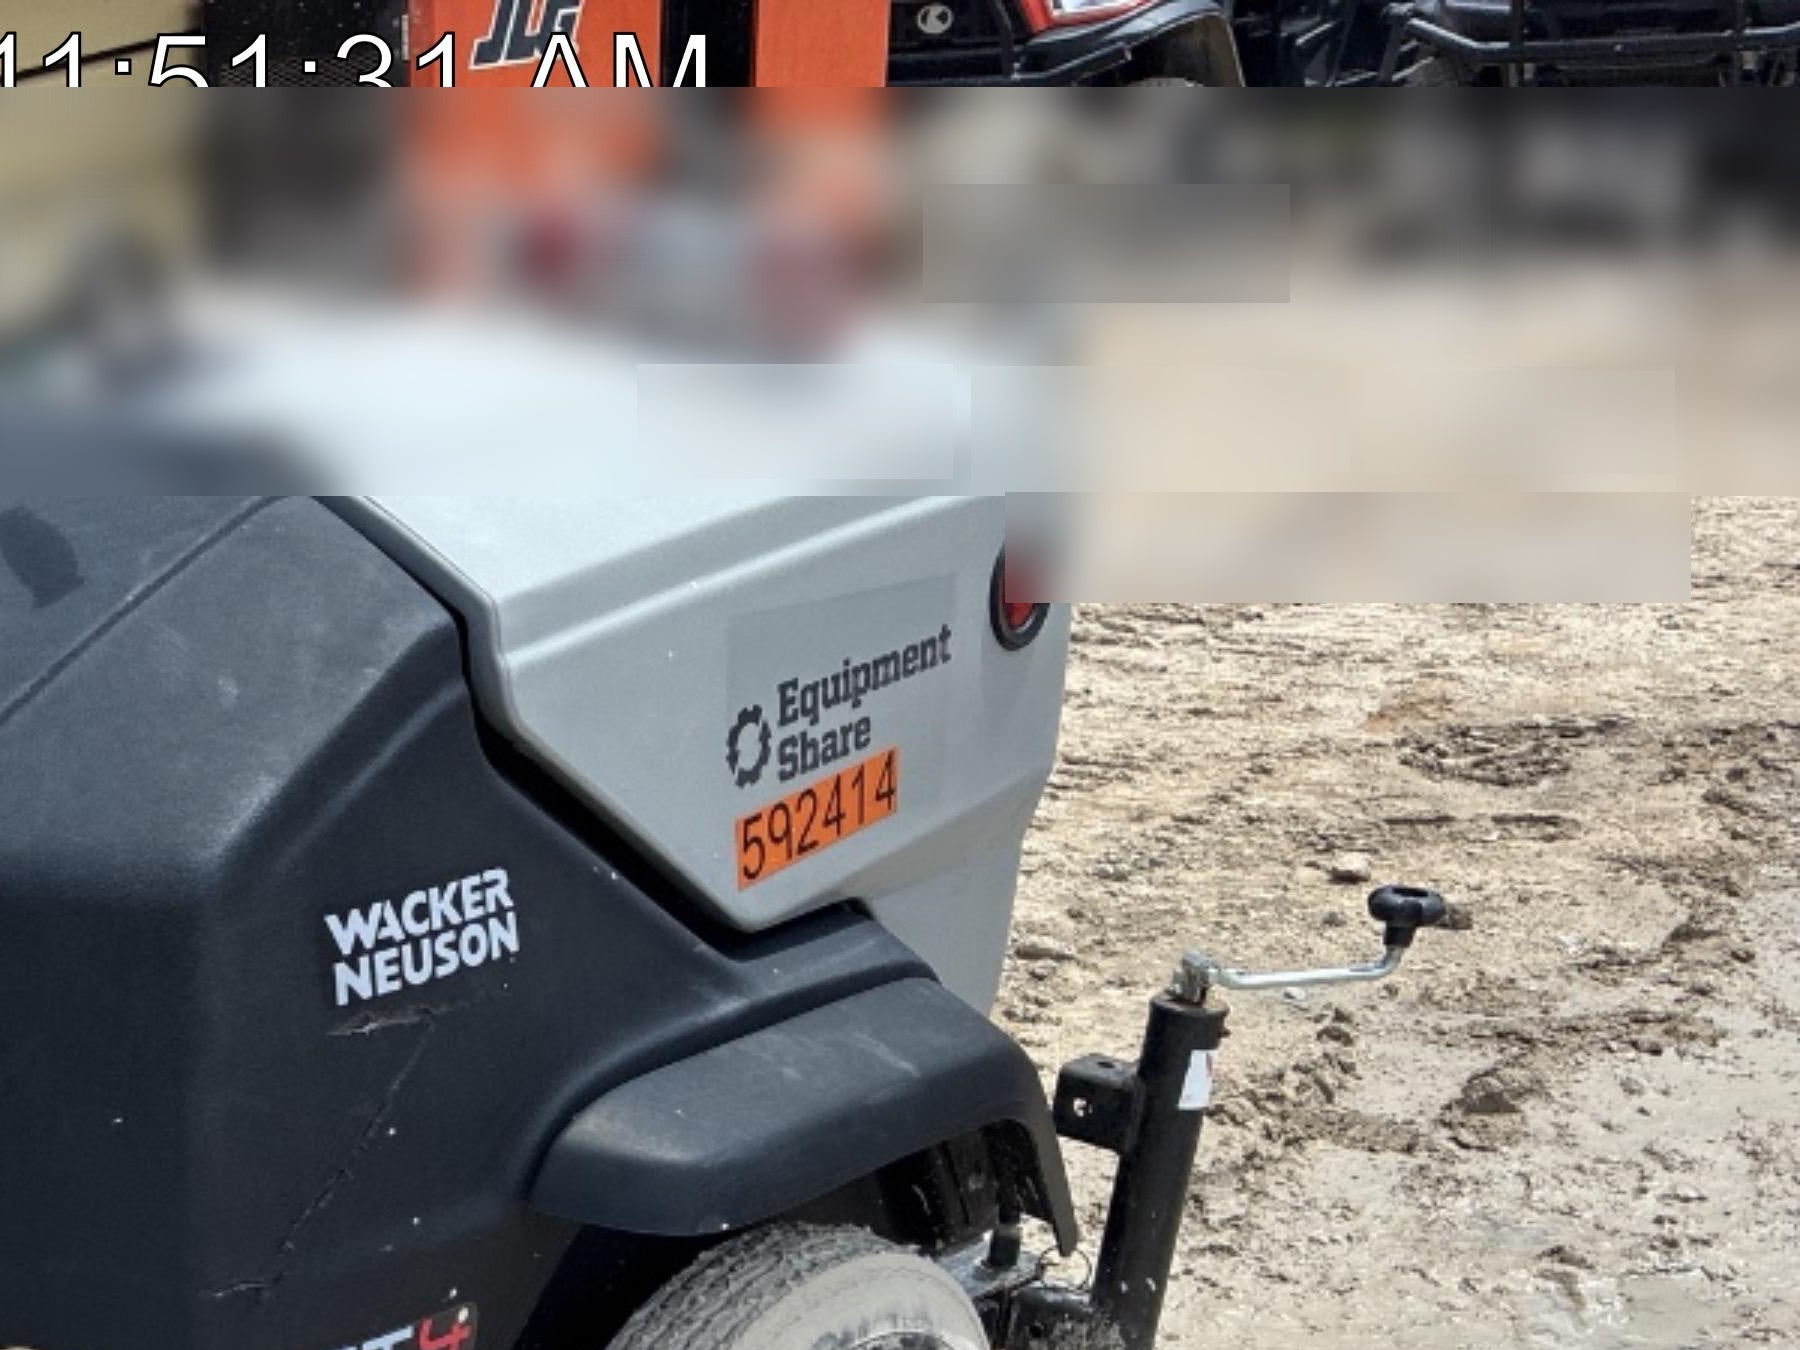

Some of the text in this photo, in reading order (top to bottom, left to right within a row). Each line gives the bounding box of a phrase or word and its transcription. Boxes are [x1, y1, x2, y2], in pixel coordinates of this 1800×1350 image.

[777, 623, 952, 727] Equipment
[777, 715, 872, 783] Share
[743, 748, 897, 881] 592414
[323, 866, 515, 956] WACKER
[333, 911, 520, 1006] NEUSON
